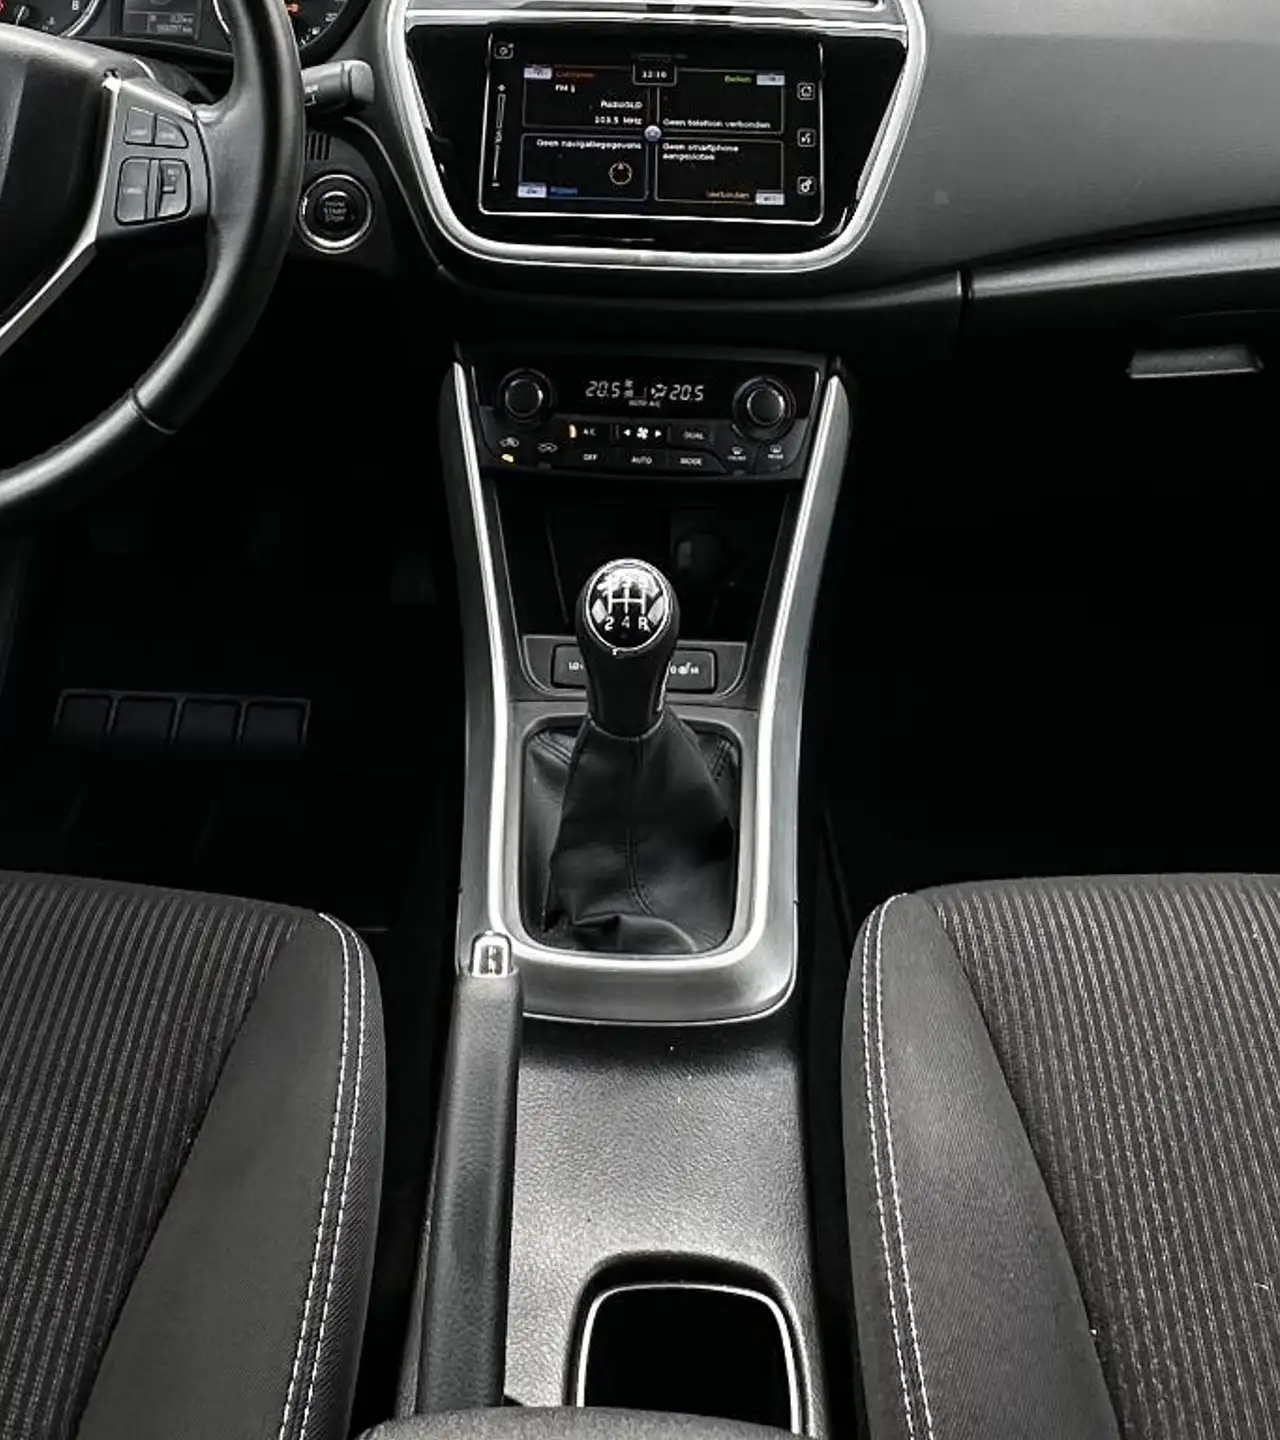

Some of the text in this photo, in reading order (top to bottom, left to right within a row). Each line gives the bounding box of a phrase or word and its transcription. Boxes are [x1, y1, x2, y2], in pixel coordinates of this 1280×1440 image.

[584, 380, 705, 401] 20.5 20.5
[630, 455, 653, 465] AUTO
[679, 456, 704, 466] MODE
[603, 615, 615, 631] 2
[620, 615, 631, 629] 4
[637, 616, 651, 631] R
